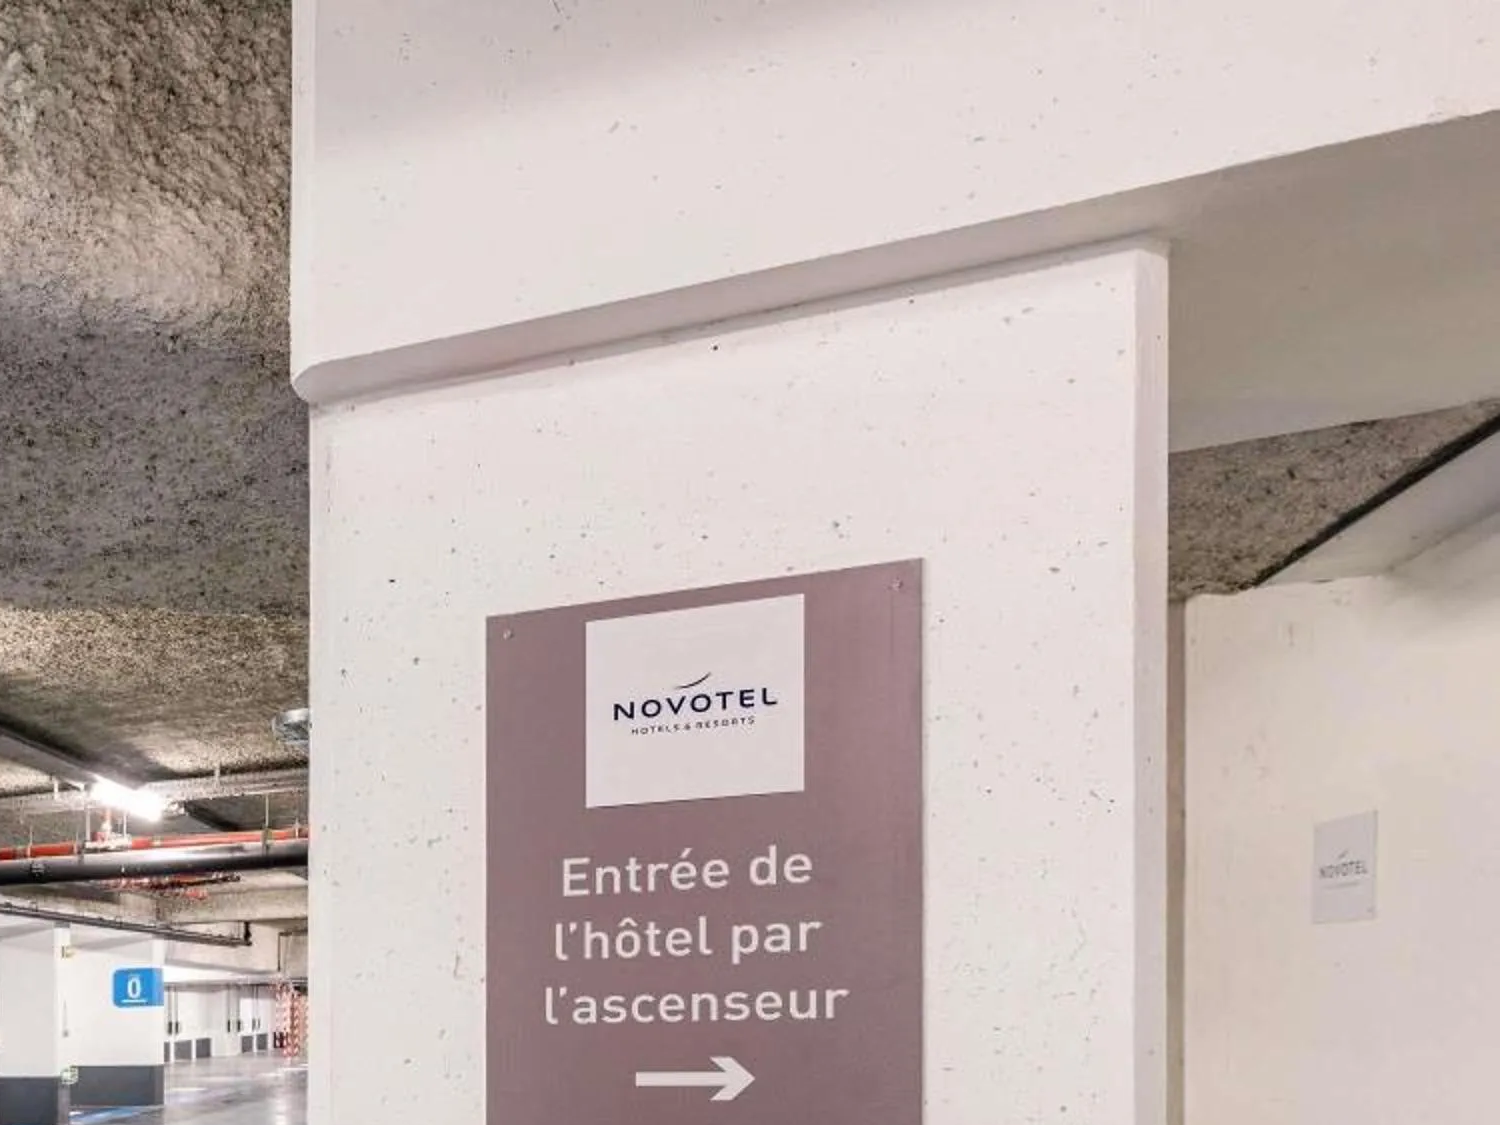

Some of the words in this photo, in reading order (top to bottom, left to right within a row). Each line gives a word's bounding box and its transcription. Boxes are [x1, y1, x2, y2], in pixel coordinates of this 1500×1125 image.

[613, 688, 778, 720] NOVOTEL
[631, 724, 680, 735] HOTELS
[695, 716, 756, 729] RESORTS
[563, 847, 729, 896] Entrée
[749, 845, 812, 886] de
[555, 917, 712, 960] l'hôtel
[732, 921, 822, 964] par
[545, 986, 849, 1024] l'ascenseur
